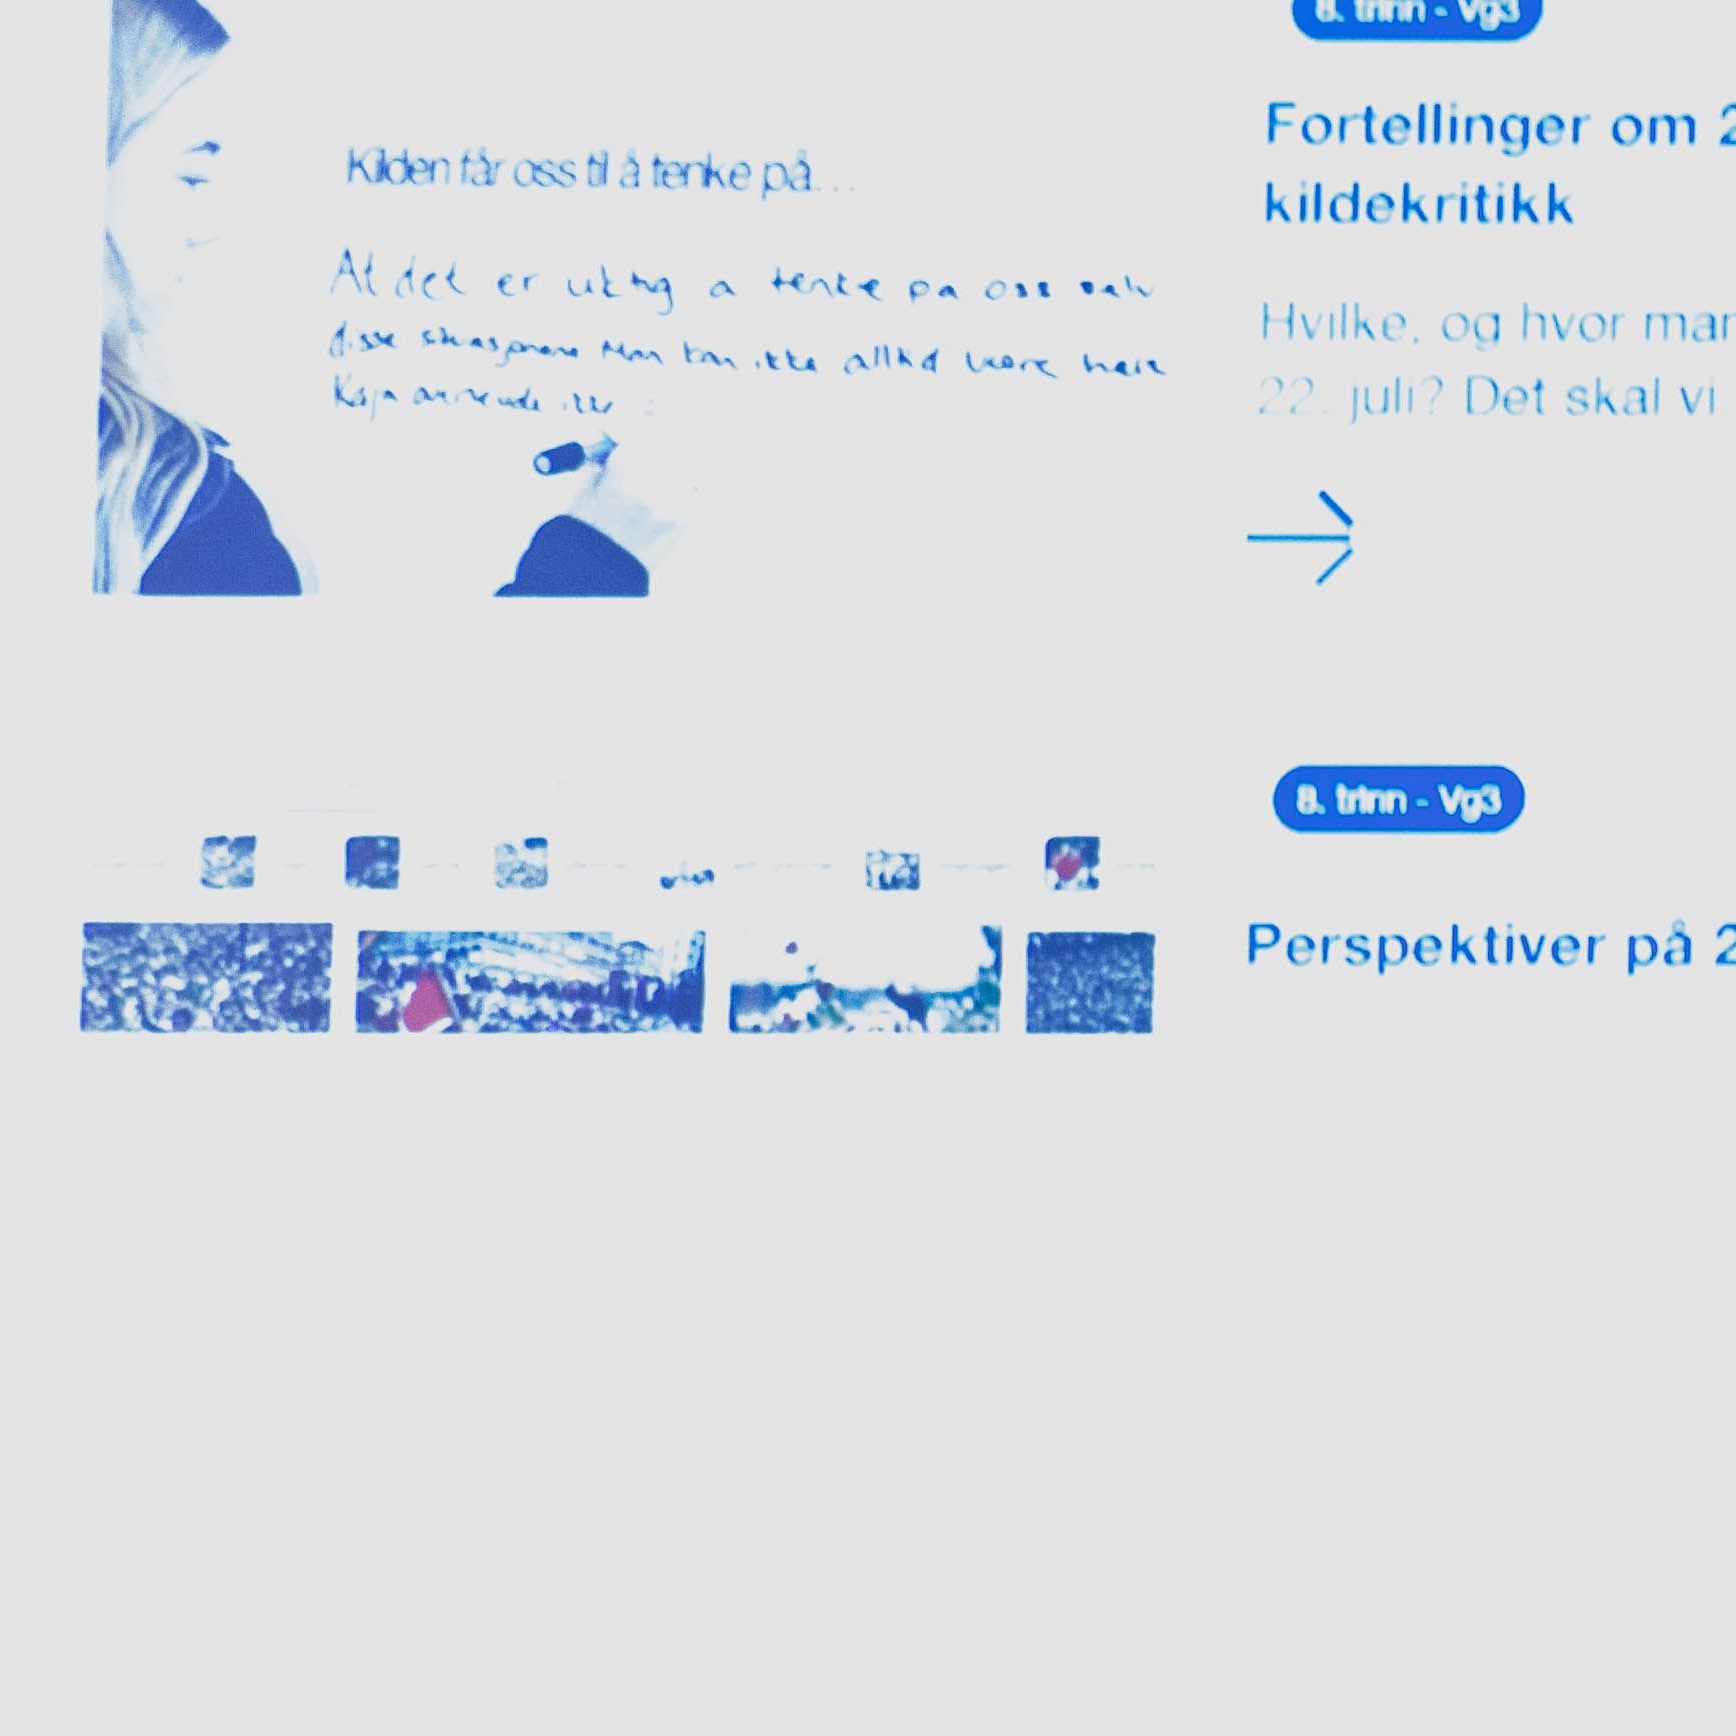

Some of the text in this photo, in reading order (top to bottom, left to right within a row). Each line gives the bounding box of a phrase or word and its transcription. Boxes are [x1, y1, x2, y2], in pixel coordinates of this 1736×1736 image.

[1266, 100, 1592, 158] Fortellinger
[1611, 112, 1697, 148] om
[346, 147, 450, 186] Kilden
[512, 157, 577, 189] oss
[585, 149, 609, 189] til
[618, 148, 641, 189] å
[650, 151, 753, 192] tenke
[1265, 180, 1575, 225] kildekritikk
[1261, 301, 1419, 345] Hvilke,
[1440, 311, 1502, 352] og
[1521, 301, 1626, 343] hvor
[1258, 374, 1716, 425] 22. juli? Det skal vi
[1295, 783, 1326, 815] 8.
[1336, 782, 1408, 815] trinn
[1438, 783, 1502, 824] Vg3
[1246, 921, 1607, 977] Perspektiver
[1627, 917, 1694, 977] på
